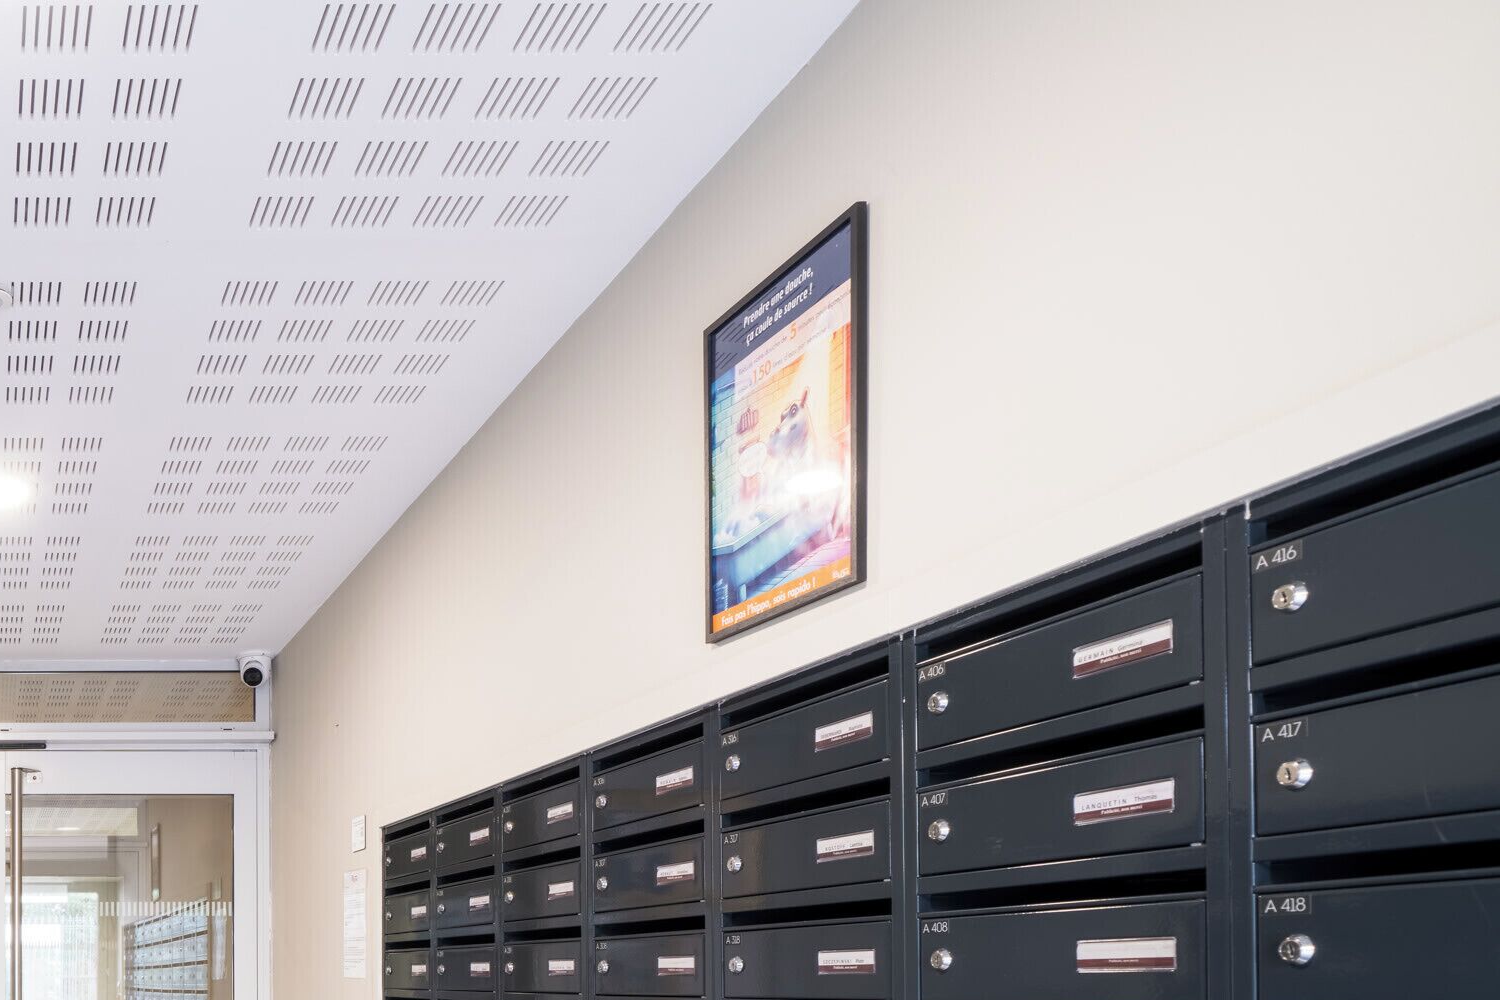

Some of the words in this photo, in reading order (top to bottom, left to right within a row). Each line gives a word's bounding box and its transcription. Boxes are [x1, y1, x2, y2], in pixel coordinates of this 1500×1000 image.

[743, 300, 770, 329] Prendre
[771, 291, 784, 306] une
[785, 266, 814, 295] douche,
[746, 332, 754, 347] ça
[755, 315, 773, 337] coule
[773, 308, 782, 323] de
[783, 291, 808, 316] source
[790, 322, 797, 340] 5
[752, 359, 772, 384] 150
[1255, 554, 1269, 570] A
[1271, 545, 1297, 564] 416
[721, 613, 734, 626] Fais
[734, 609, 746, 623] pas
[772, 591, 786, 604] sois
[787, 580, 811, 599] rapido
[1078, 646, 1114, 663] GERMAIN
[919, 670, 926, 682] A
[927, 665, 943, 677] 406
[1261, 728, 1274, 743] A
[1277, 721, 1302, 738] 417
[921, 797, 929, 807] A
[930, 792, 946, 805] 407
[1081, 796, 1127, 812] LANQUETIN
[1134, 791, 1157, 802] Thomas
[1263, 899, 1277, 914] A
[1280, 896, 1306, 912] 418
[922, 923, 930, 934] A
[931, 921, 948, 933] 408
